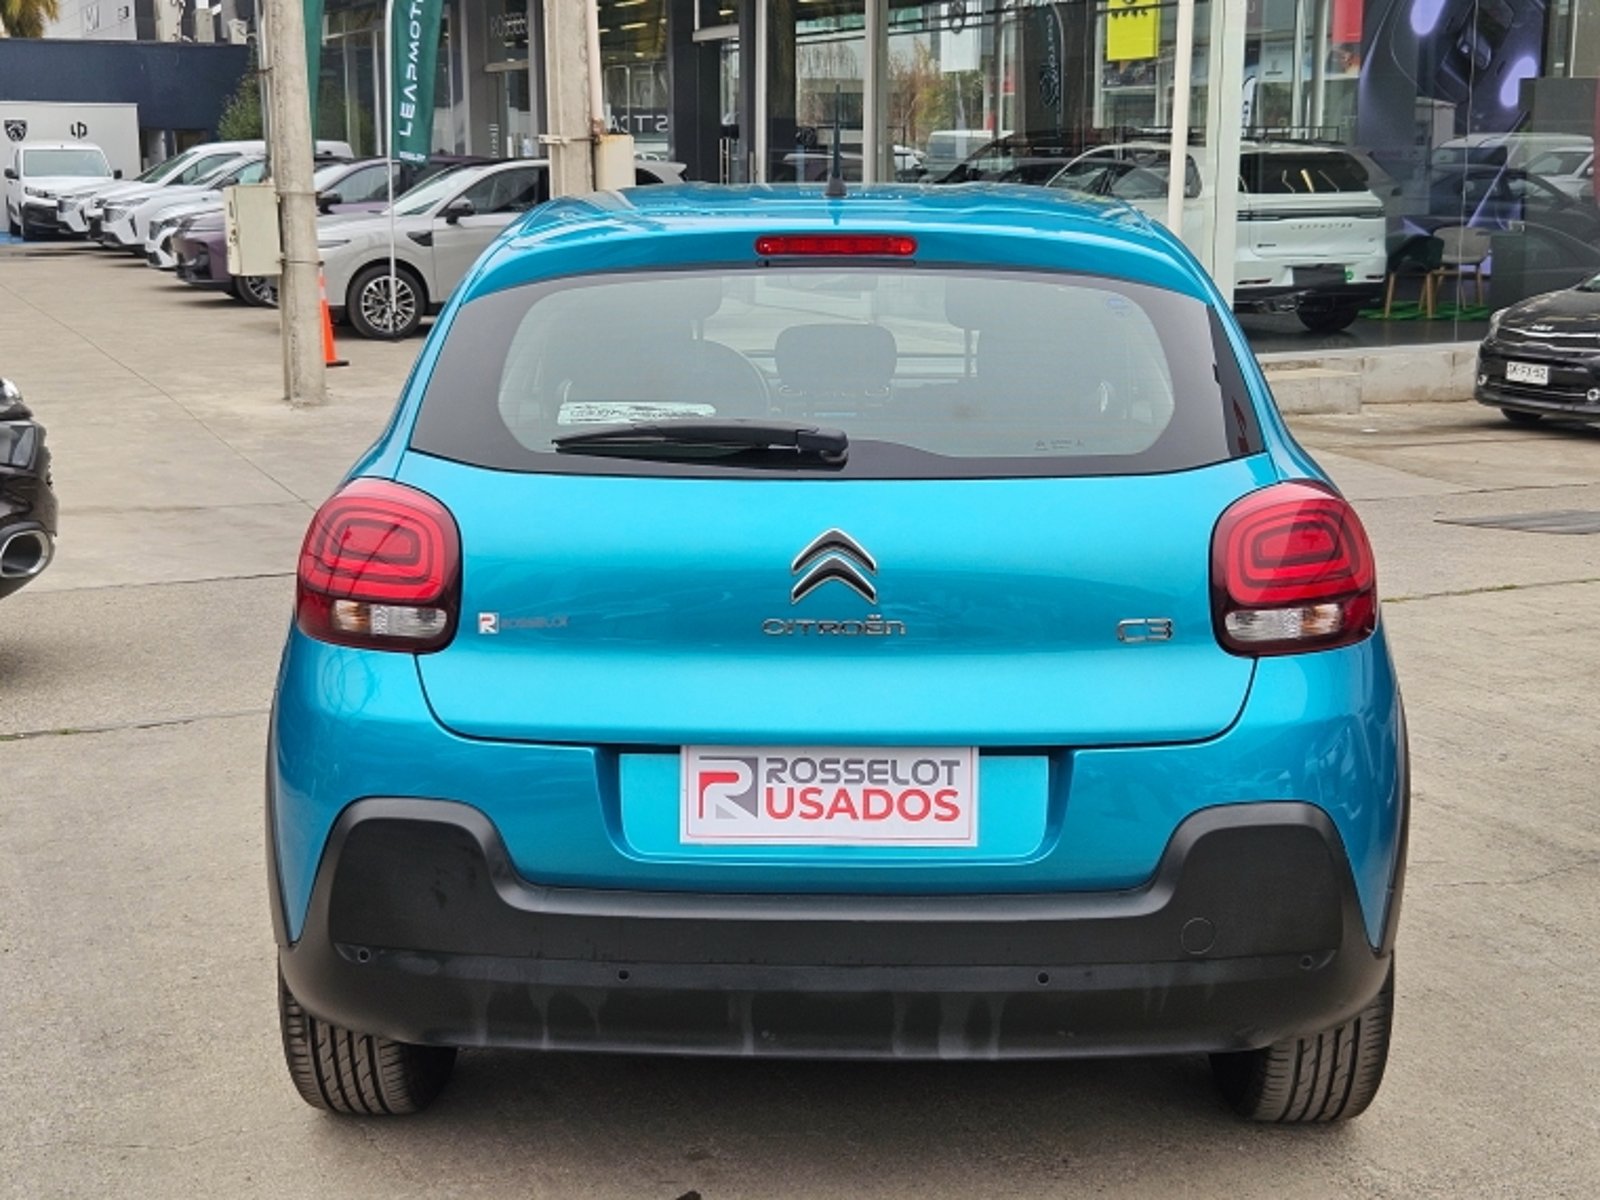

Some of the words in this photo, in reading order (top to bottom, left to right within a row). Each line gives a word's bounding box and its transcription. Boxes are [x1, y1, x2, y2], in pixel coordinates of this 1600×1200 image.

[399, 0, 425, 137] LEAPMOT
[1116, 617, 1173, 644] C3
[766, 757, 961, 786] ROSSELOT
[766, 787, 961, 822] USADOS
